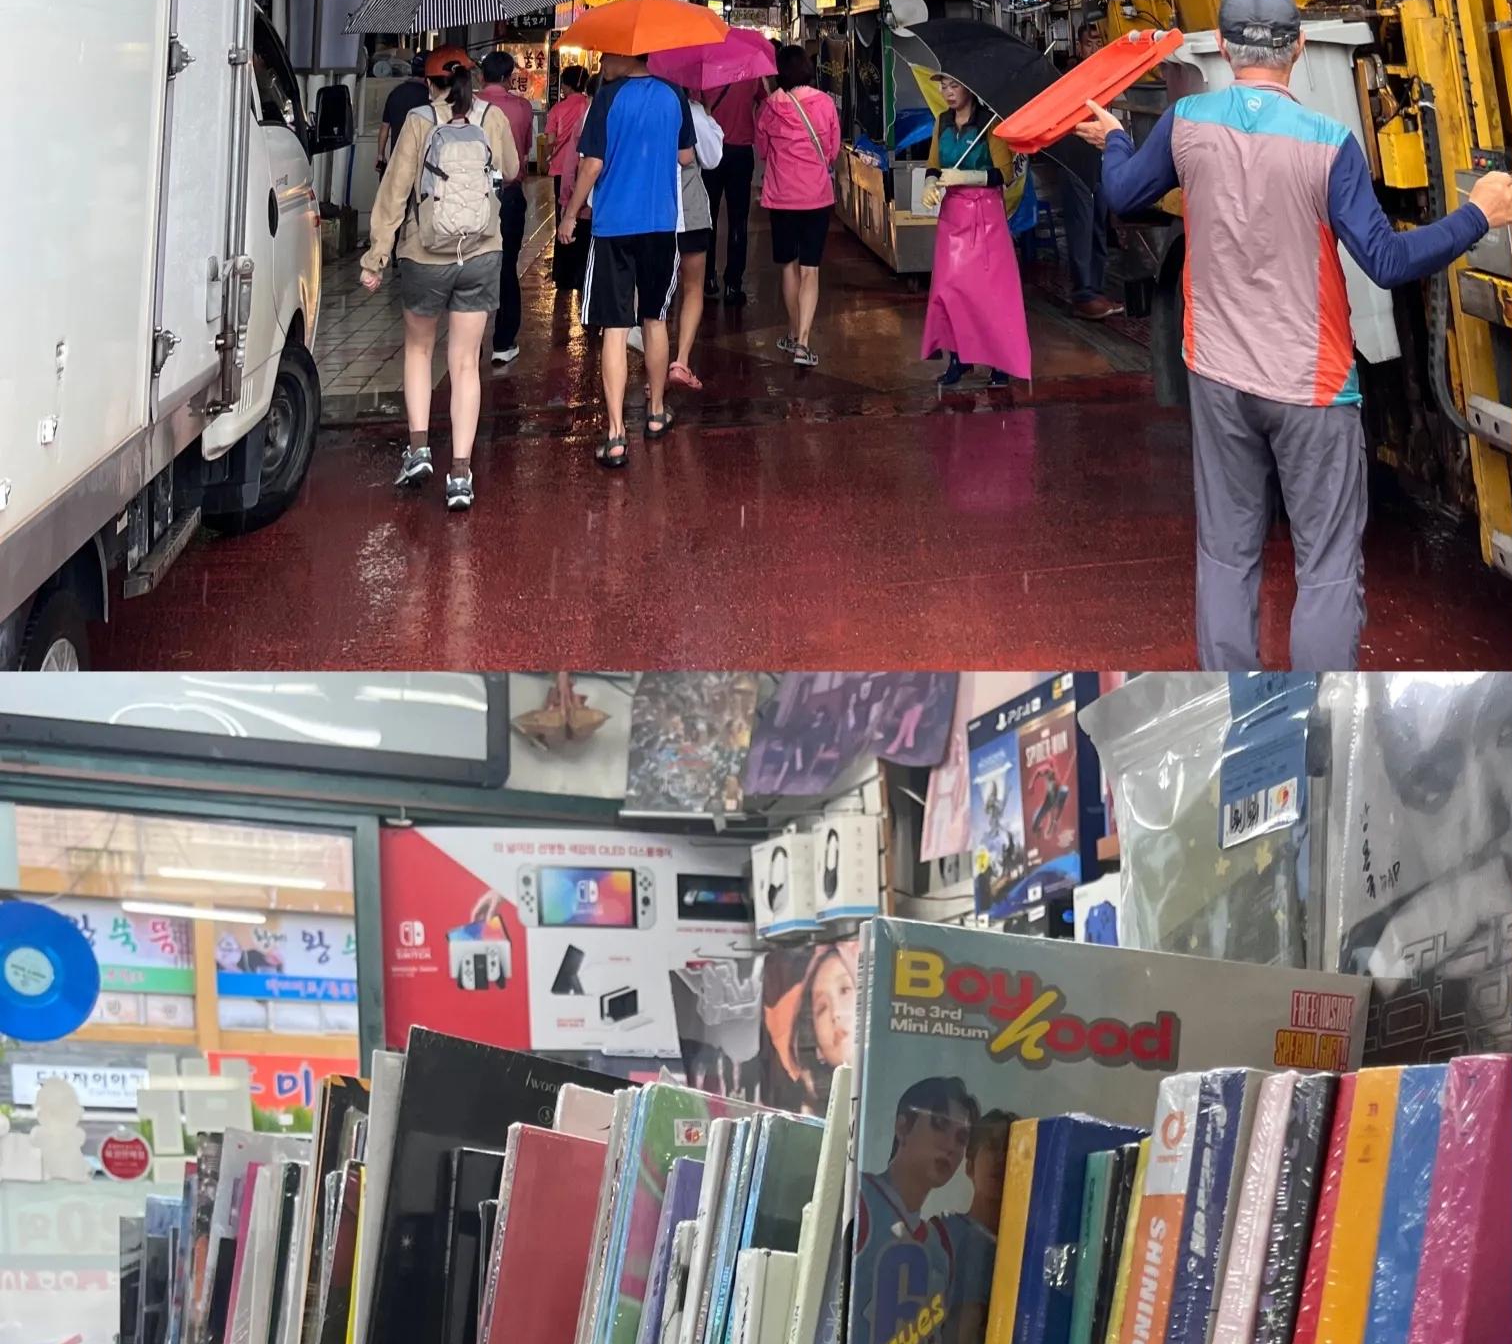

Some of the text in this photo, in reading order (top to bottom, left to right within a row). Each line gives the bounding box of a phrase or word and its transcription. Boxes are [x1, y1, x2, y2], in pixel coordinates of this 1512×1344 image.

[599, 844, 625, 856] OLED
[891, 1002, 963, 1022] The 3rd
[1291, 990, 1355, 1031] FREE INSIDE
[890, 1018, 989, 1041] Mini Album
[1274, 1028, 1317, 1068] SPECIAL
